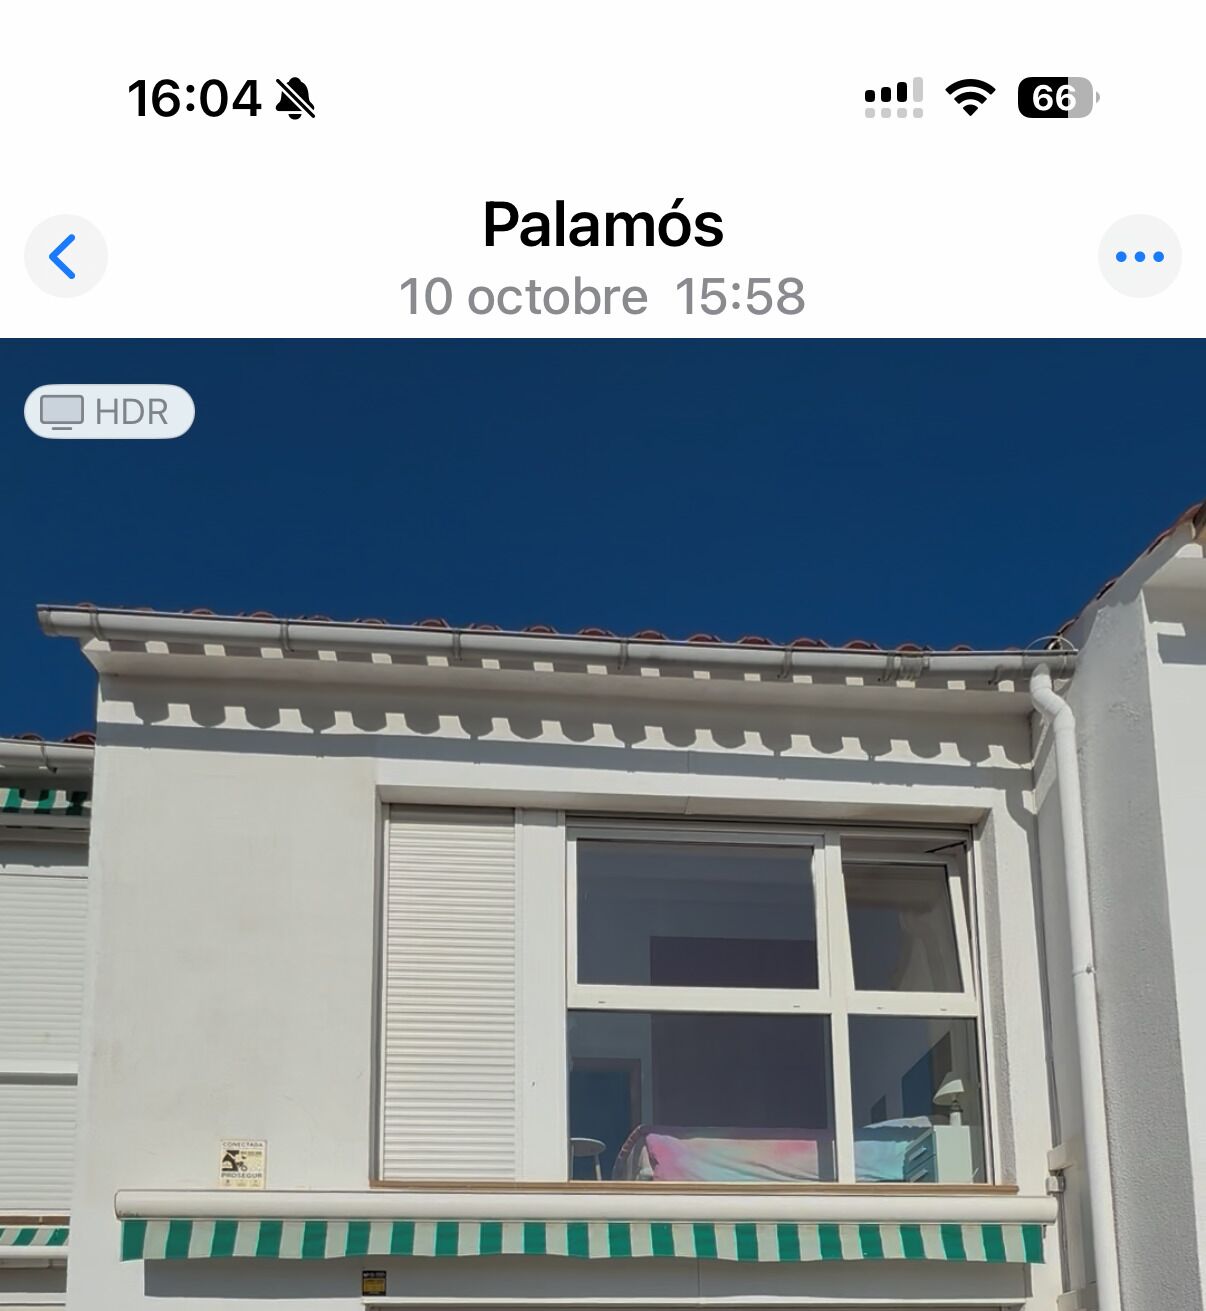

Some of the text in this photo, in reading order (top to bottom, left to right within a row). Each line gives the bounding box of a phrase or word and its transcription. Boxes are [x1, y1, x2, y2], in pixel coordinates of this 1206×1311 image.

[129, 79, 262, 117] 16:04
[1032, 84, 1076, 111] 66
[484, 198, 724, 248] Palamós
[400, 276, 806, 316] 10 octobre 15:58
[96, 398, 169, 425] HDR
